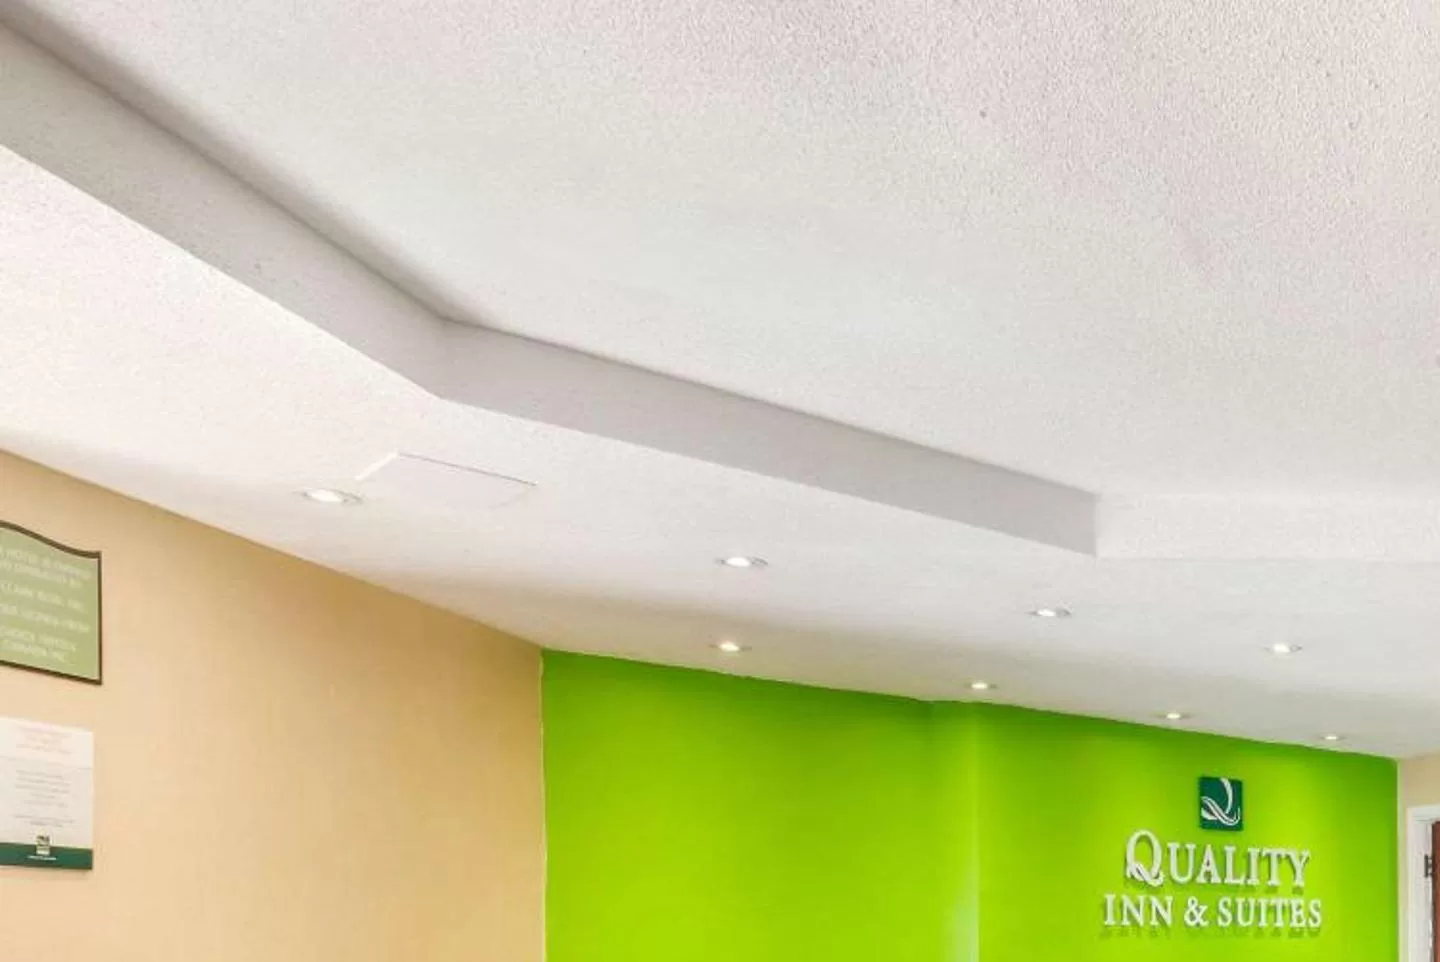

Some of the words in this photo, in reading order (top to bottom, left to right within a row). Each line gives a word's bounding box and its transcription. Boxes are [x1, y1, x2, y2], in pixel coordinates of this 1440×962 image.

[1125, 829, 1312, 887] QUALITY
[1103, 893, 1173, 927] INN
[1184, 896, 1209, 927] &
[1217, 896, 1322, 928] SUITES
